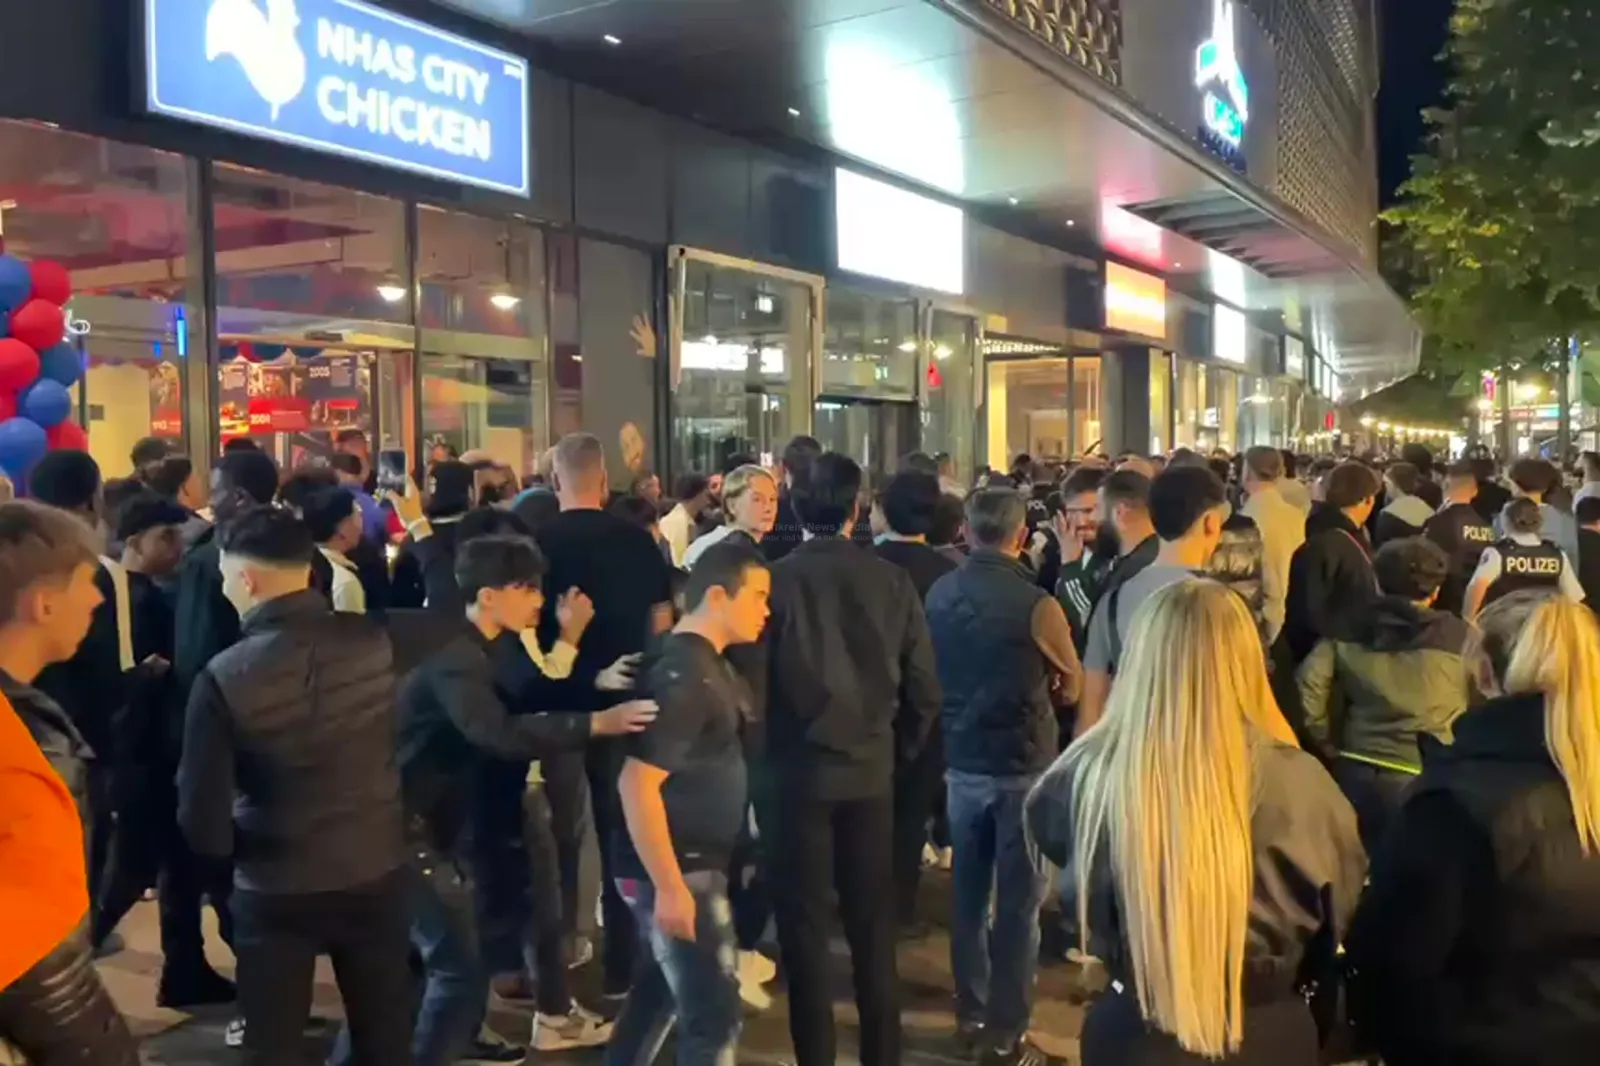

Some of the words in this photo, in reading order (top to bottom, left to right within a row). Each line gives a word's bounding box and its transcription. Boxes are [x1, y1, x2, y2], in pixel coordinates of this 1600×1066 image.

[316, 17, 416, 84] NHAS
[421, 54, 490, 105] CITY
[316, 75, 492, 162] CHICKEN
[1506, 556, 1560, 574] POLIZEI
